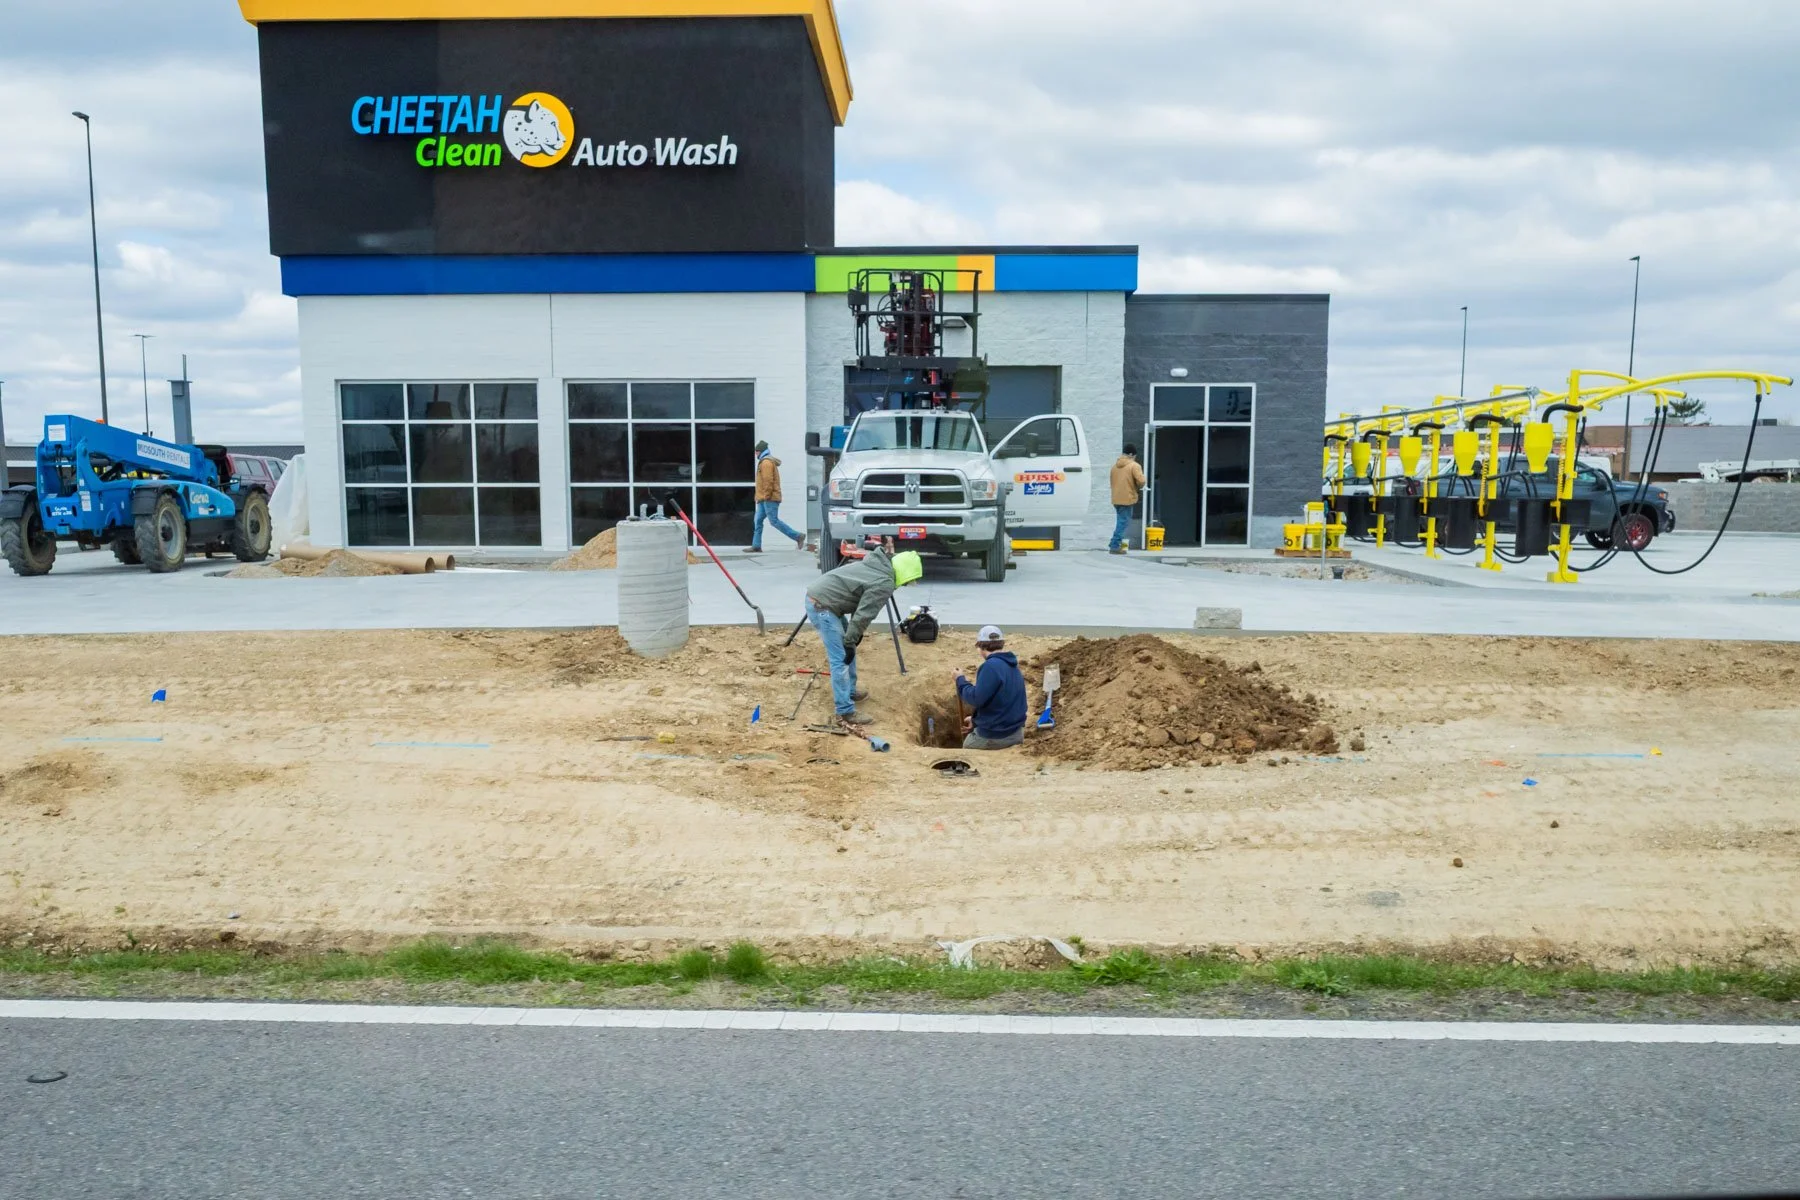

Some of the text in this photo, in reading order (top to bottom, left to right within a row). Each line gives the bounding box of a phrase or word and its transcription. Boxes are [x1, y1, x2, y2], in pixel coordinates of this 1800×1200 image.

[351, 94, 502, 134] CHEETAH
[415, 137, 502, 168] Clean
[572, 135, 738, 168] Auto Wash
[137, 443, 166, 459] MIDSOUTH
[1019, 474, 1061, 482] HUSK
